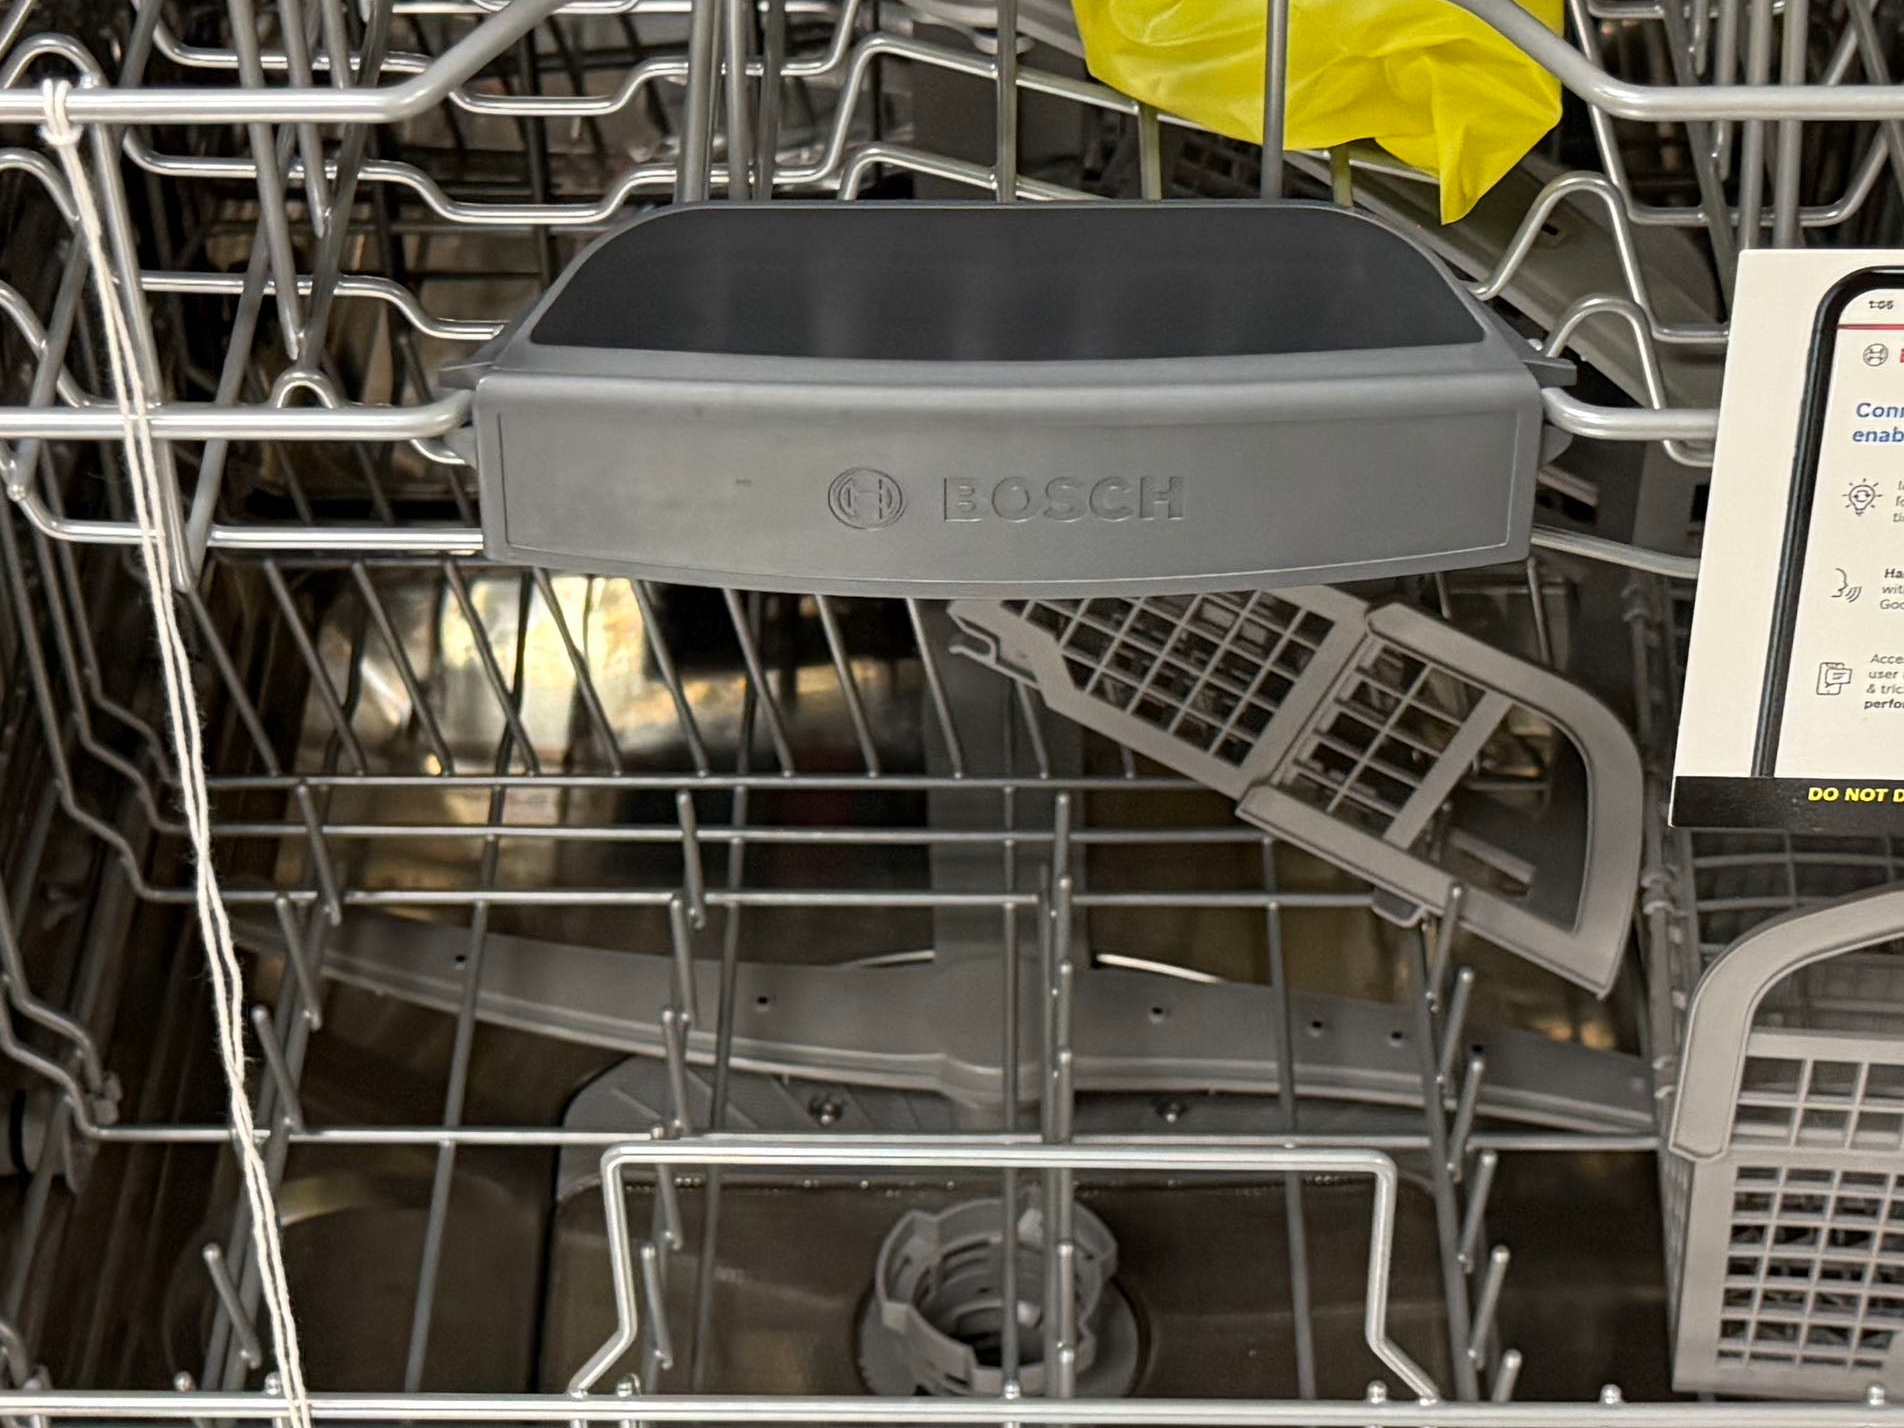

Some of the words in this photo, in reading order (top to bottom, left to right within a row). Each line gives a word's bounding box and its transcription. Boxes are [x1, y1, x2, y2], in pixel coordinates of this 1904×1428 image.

[943, 476, 1186, 524] BOSCH
[1867, 670, 1899, 681] user
[1865, 683, 1877, 695] &
[1807, 786, 1840, 802] DO
[1845, 787, 1889, 802] NOT
